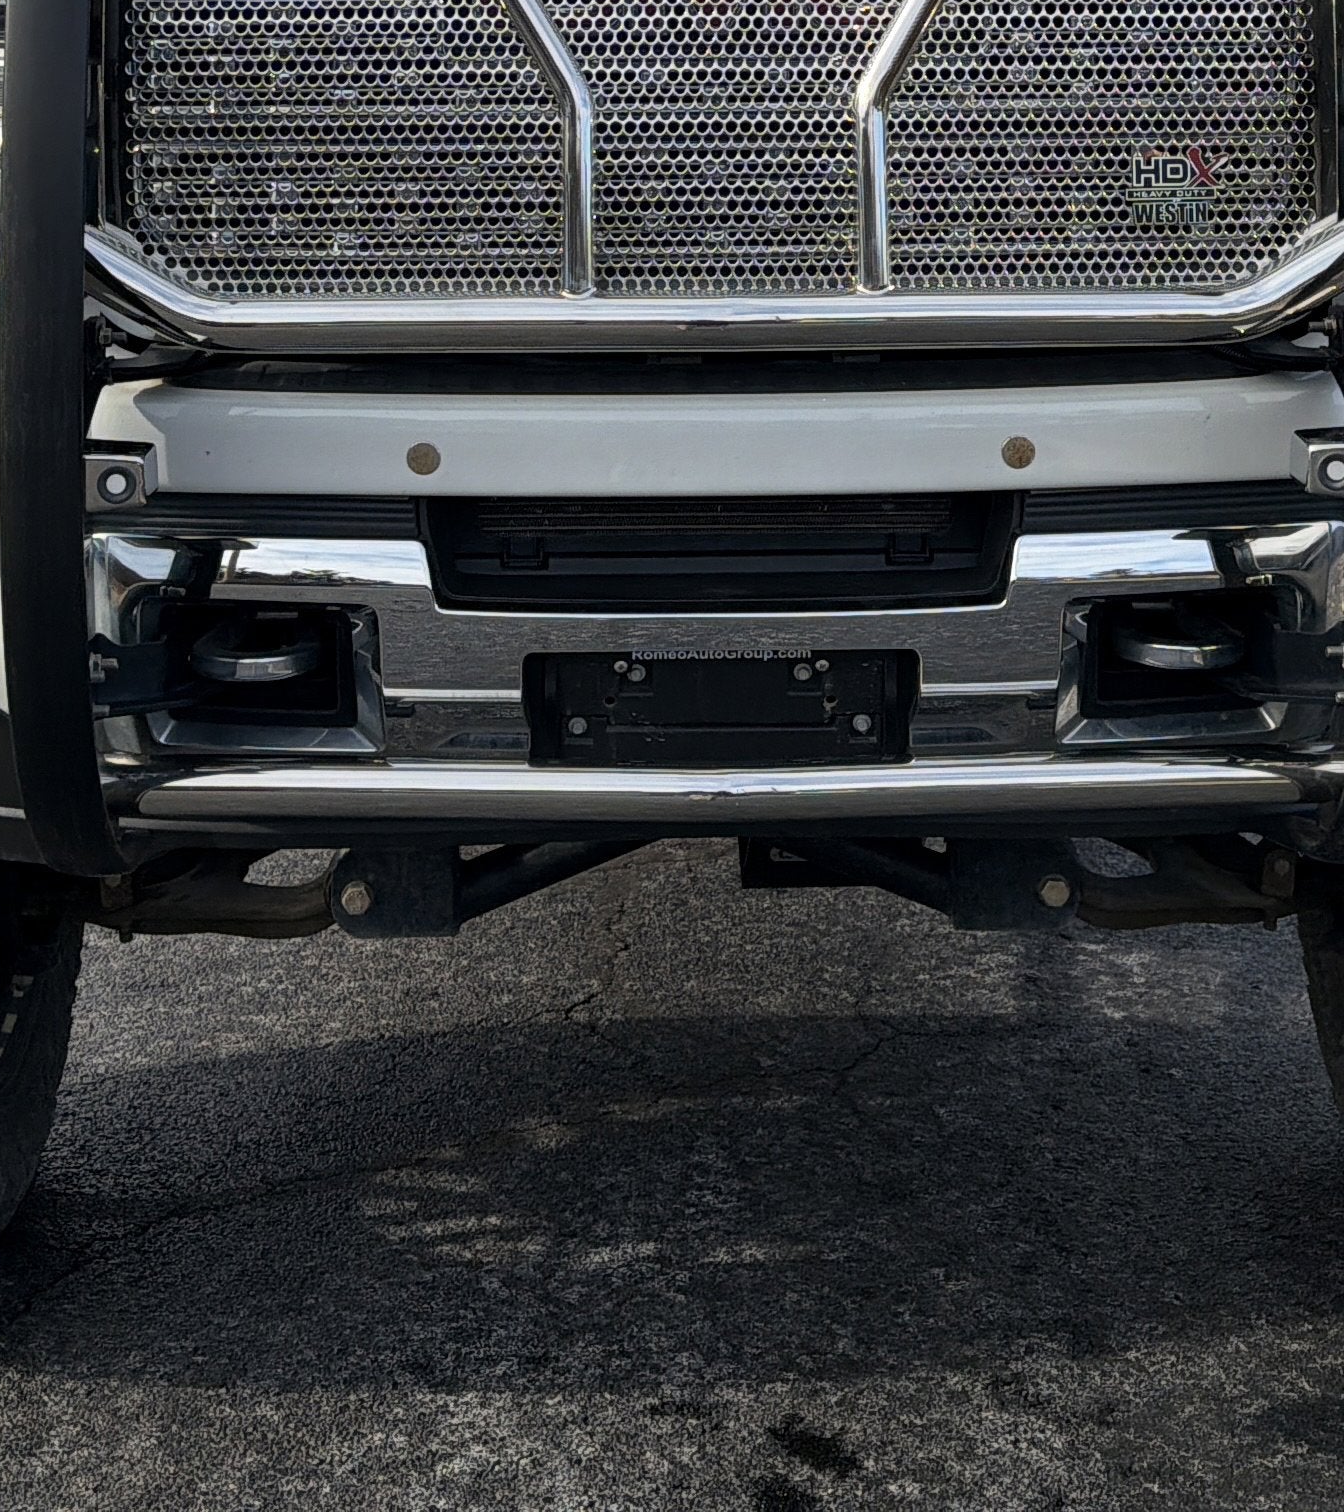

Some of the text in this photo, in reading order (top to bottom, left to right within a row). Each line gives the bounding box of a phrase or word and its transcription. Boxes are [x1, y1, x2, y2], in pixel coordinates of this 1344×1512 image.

[1132, 146, 1230, 188] HDX
[1176, 189, 1207, 197] DUTY
[632, 649, 812, 661] RomeoAutoGroup.com
